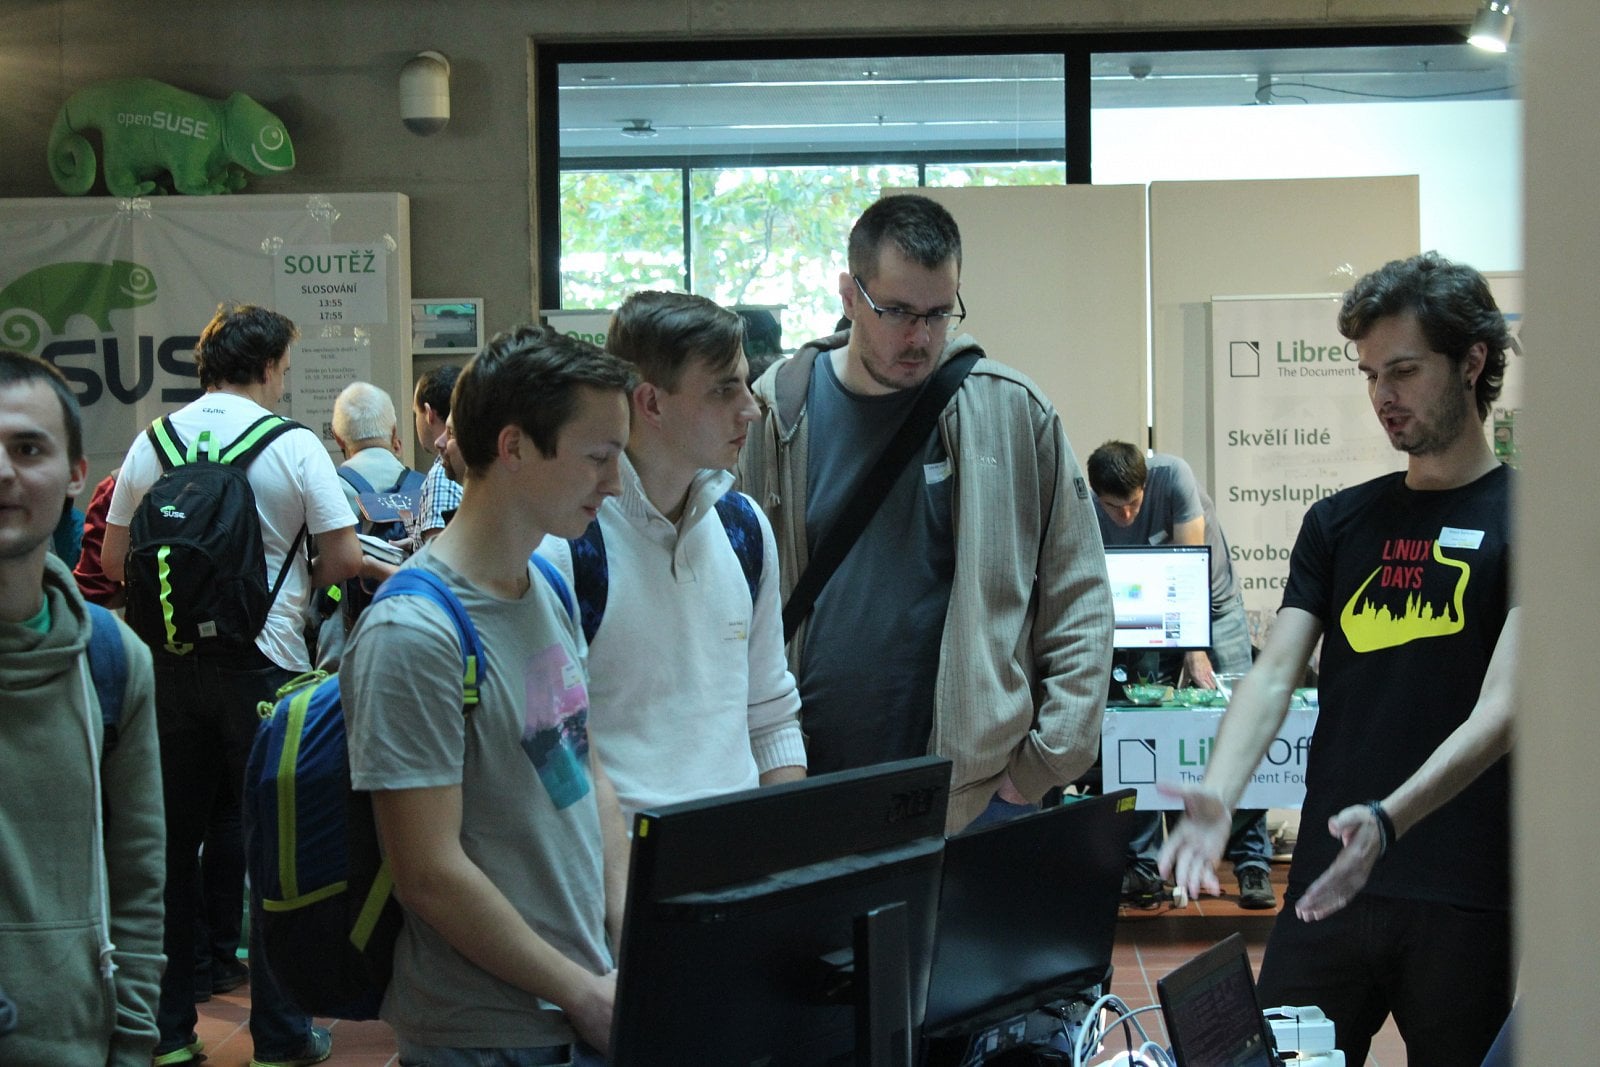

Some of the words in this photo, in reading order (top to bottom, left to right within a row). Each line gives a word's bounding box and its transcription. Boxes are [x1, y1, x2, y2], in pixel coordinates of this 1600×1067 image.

[118, 110, 209, 140] openSUSE
[284, 249, 376, 274] SOUTĚŽ
[301, 283, 357, 294] SLOSOVÁNÍ
[320, 312, 343, 320] 17:55
[1278, 367, 1297, 377] The
[1300, 366, 1355, 377] Document
[1228, 428, 1288, 446] Skvělí
[1294, 428, 1331, 445] lidé
[1382, 539, 1432, 561] LINUX
[1381, 565, 1424, 589] DAYS
